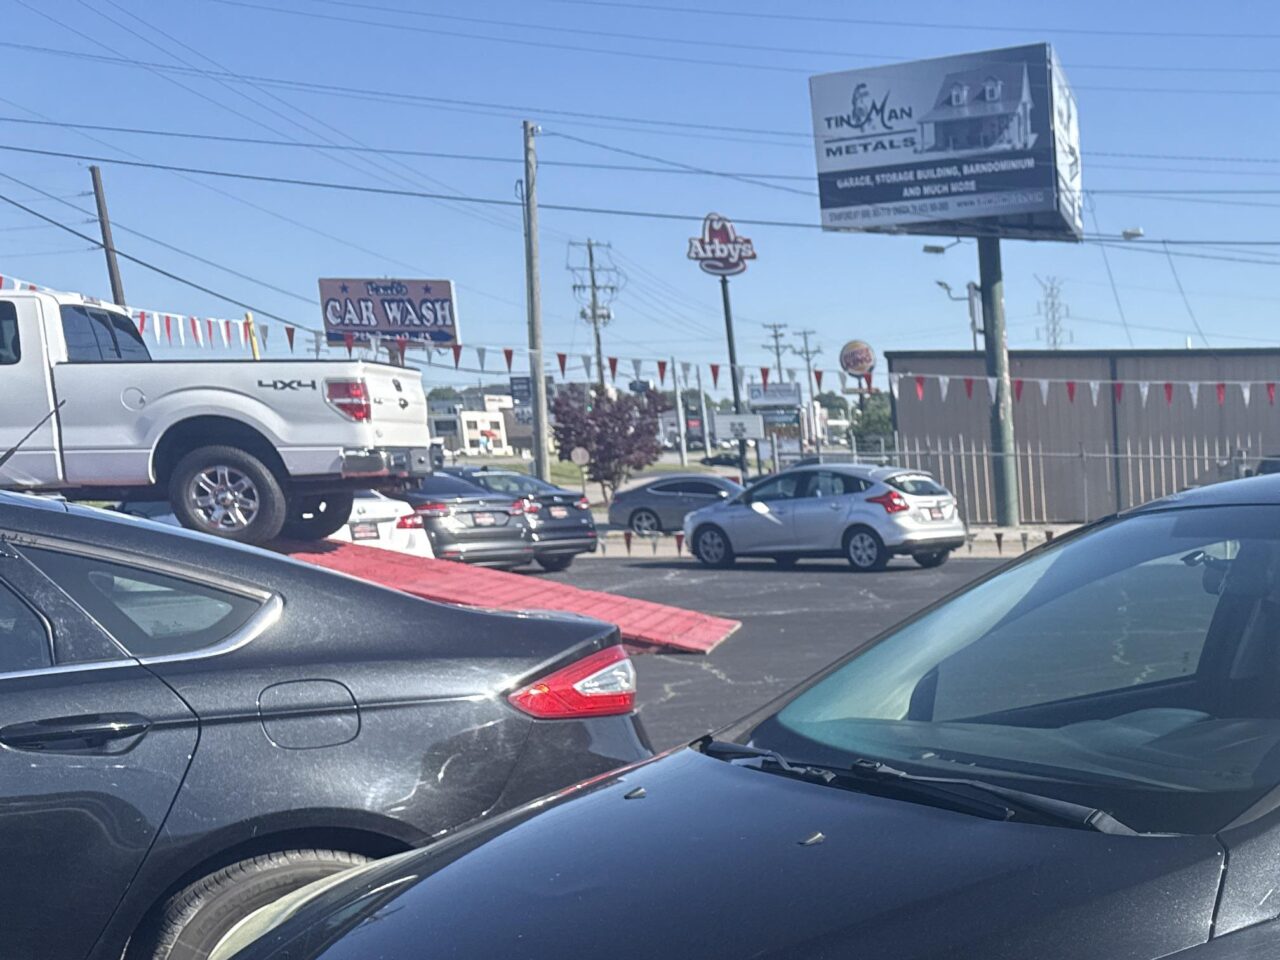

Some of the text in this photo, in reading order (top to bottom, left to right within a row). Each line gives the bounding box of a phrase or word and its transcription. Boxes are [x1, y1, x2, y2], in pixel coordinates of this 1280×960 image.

[824, 88, 912, 130] TIN MAN
[826, 137, 917, 157] METALS
[875, 171, 915, 184] STORAGE
[962, 158, 1035, 176] BARNDOMINIUM
[902, 180, 976, 198] AND MUCH MORE
[326, 299, 453, 328] CAR WASH
